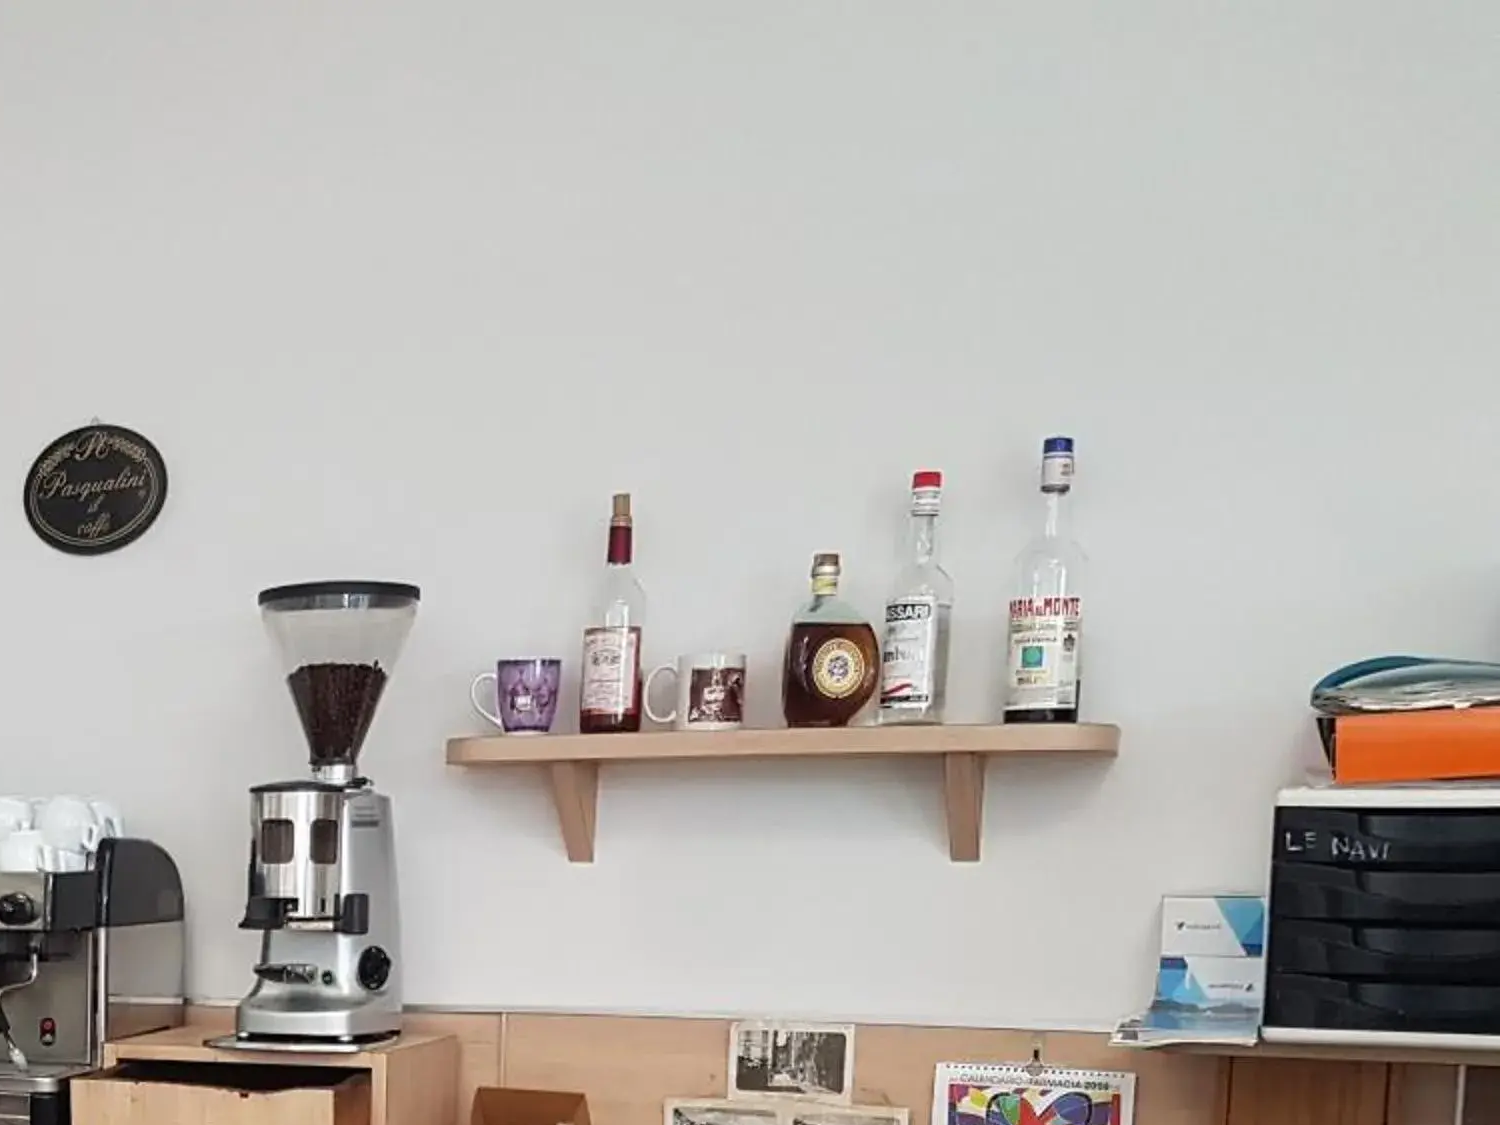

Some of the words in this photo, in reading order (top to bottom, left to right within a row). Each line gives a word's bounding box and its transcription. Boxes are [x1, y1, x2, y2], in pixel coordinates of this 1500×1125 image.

[38, 466, 147, 501] Pasqualini
[1044, 597, 1081, 617] MONTE
[1286, 831, 1317, 851] LE
[1331, 837, 1391, 861] NAVI
